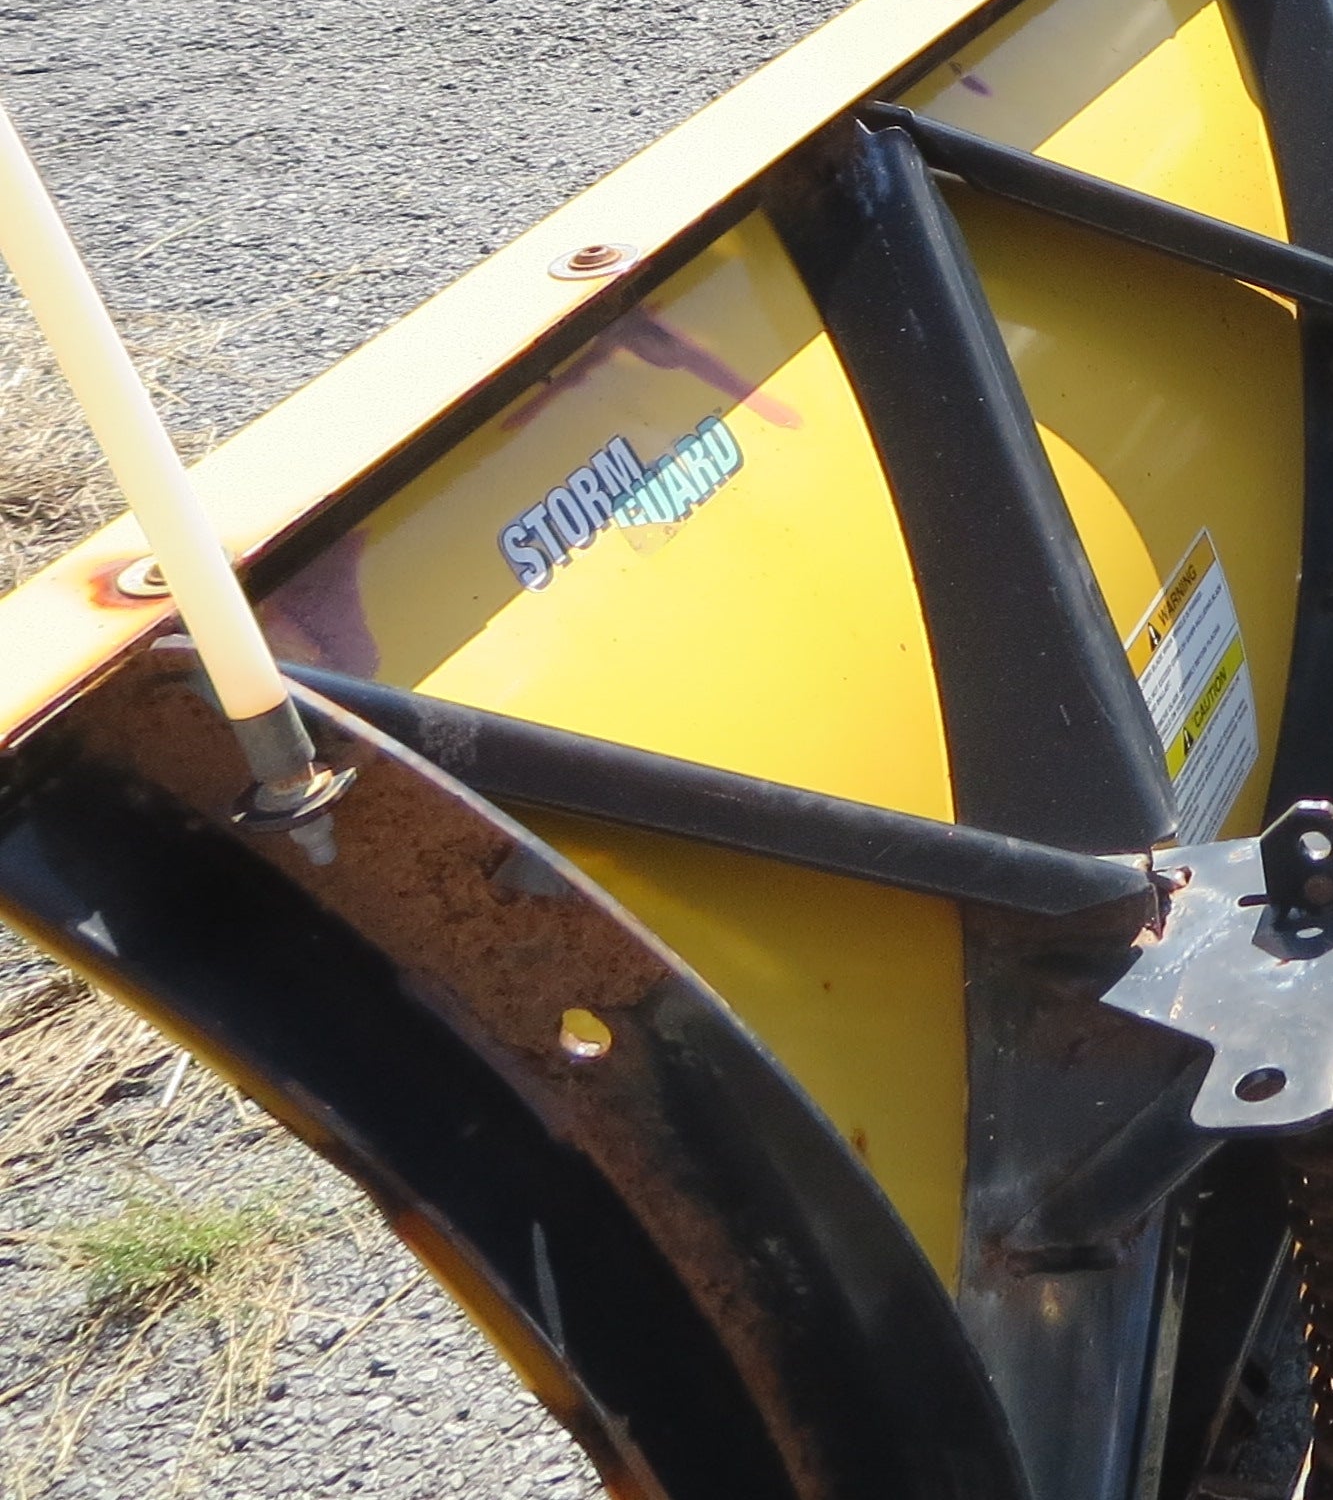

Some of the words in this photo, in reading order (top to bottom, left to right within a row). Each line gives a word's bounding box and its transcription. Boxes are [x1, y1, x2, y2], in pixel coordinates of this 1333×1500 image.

[497, 434, 648, 592] STORM
[1158, 564, 1198, 626] WARNING
[1193, 667, 1228, 728] CAUTION
